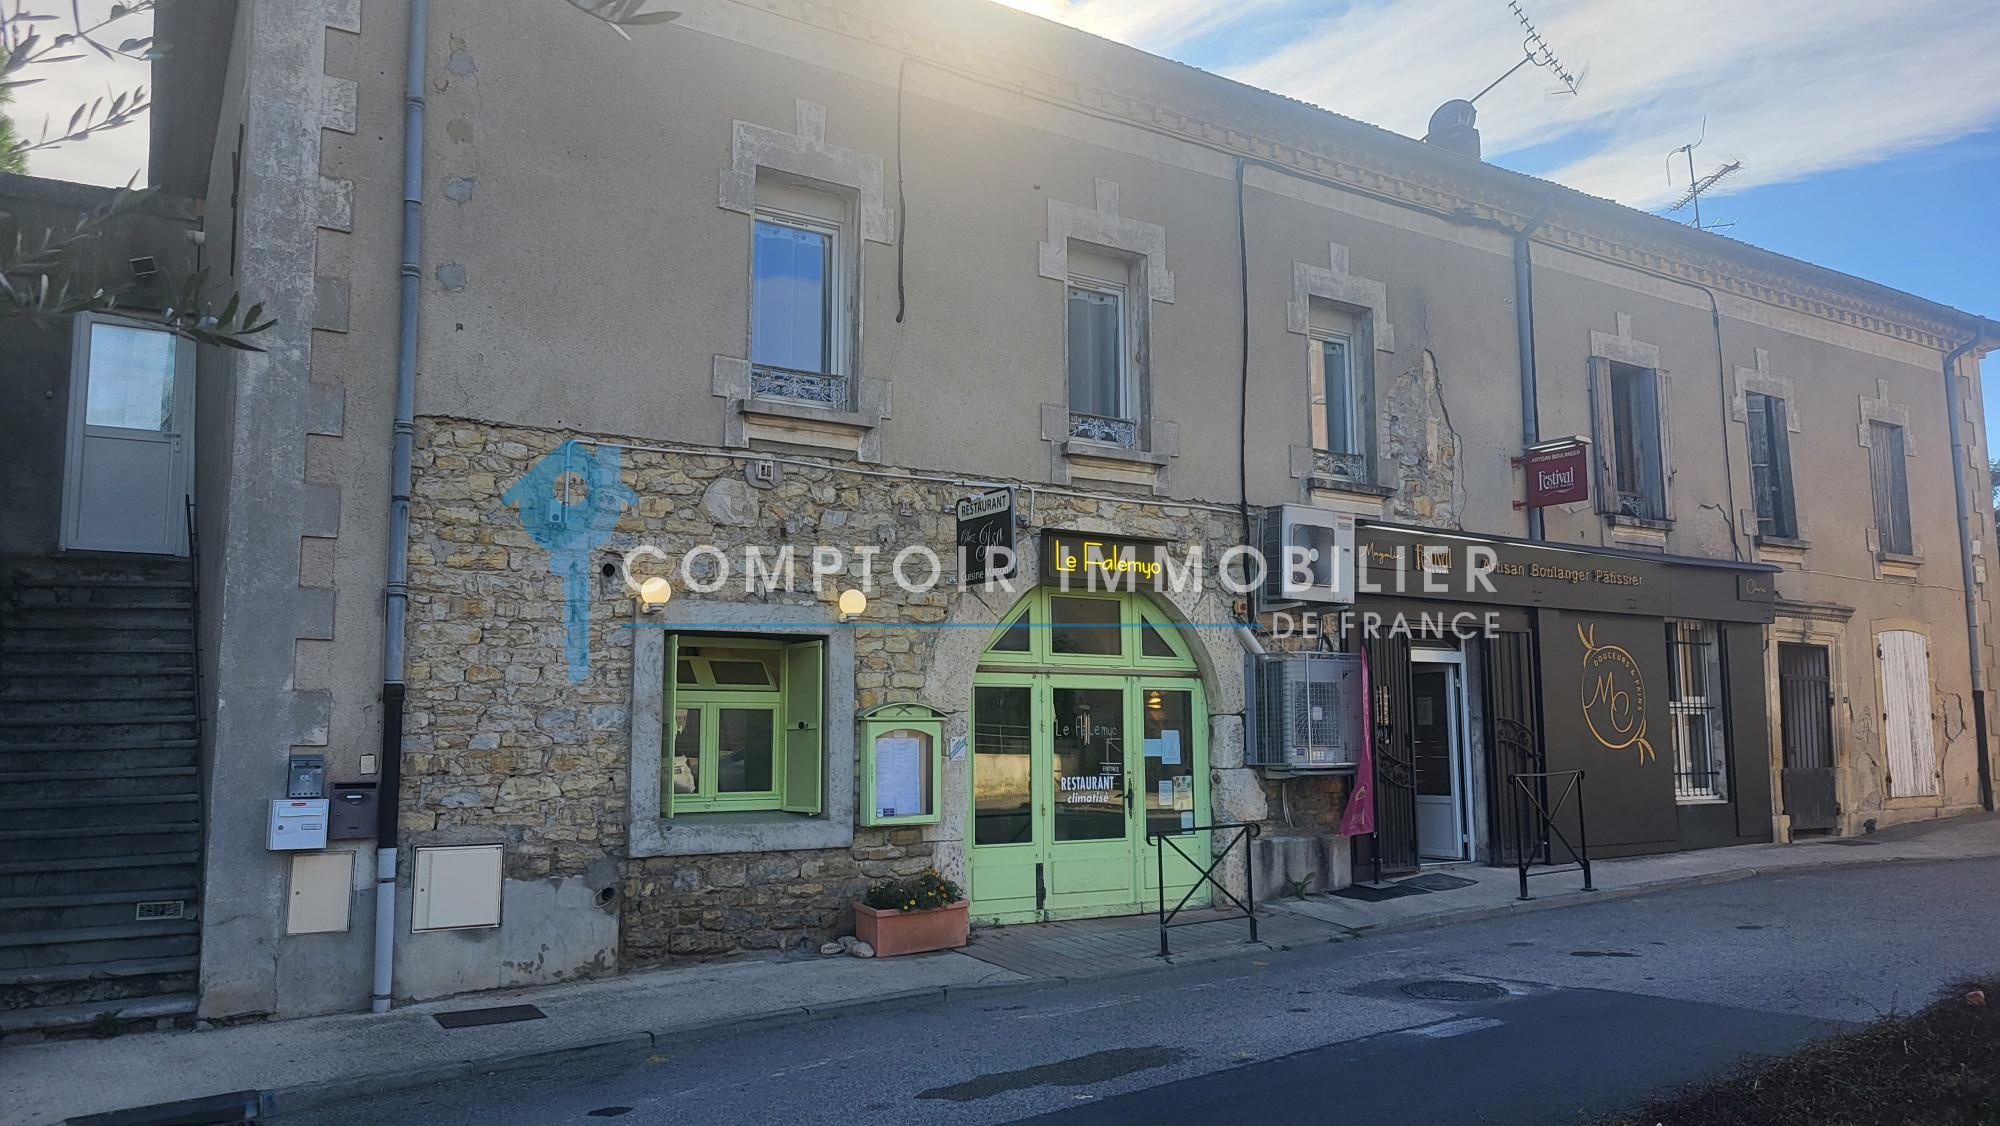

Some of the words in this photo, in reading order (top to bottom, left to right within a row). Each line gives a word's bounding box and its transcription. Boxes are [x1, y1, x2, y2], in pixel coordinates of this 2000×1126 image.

[1538, 466, 1574, 491] Festival
[961, 495, 1007, 518] RESTAURANT
[1055, 539, 1077, 572] Le
[1084, 541, 1161, 579] Falemyo
[1359, 542, 1406, 564] Magalie
[960, 569, 984, 583] Cuisine
[985, 565, 1009, 578] Maison
[1482, 558, 1525, 577] Artisan
[1531, 563, 1590, 583] Boulanger
[1593, 651, 1631, 669] DOUCEURS
[1634, 679, 1642, 712] PAINS
[1055, 720, 1070, 737] Le
[1061, 776, 1114, 791] RESTAURANT
[1067, 792, 1109, 804] climatisé
